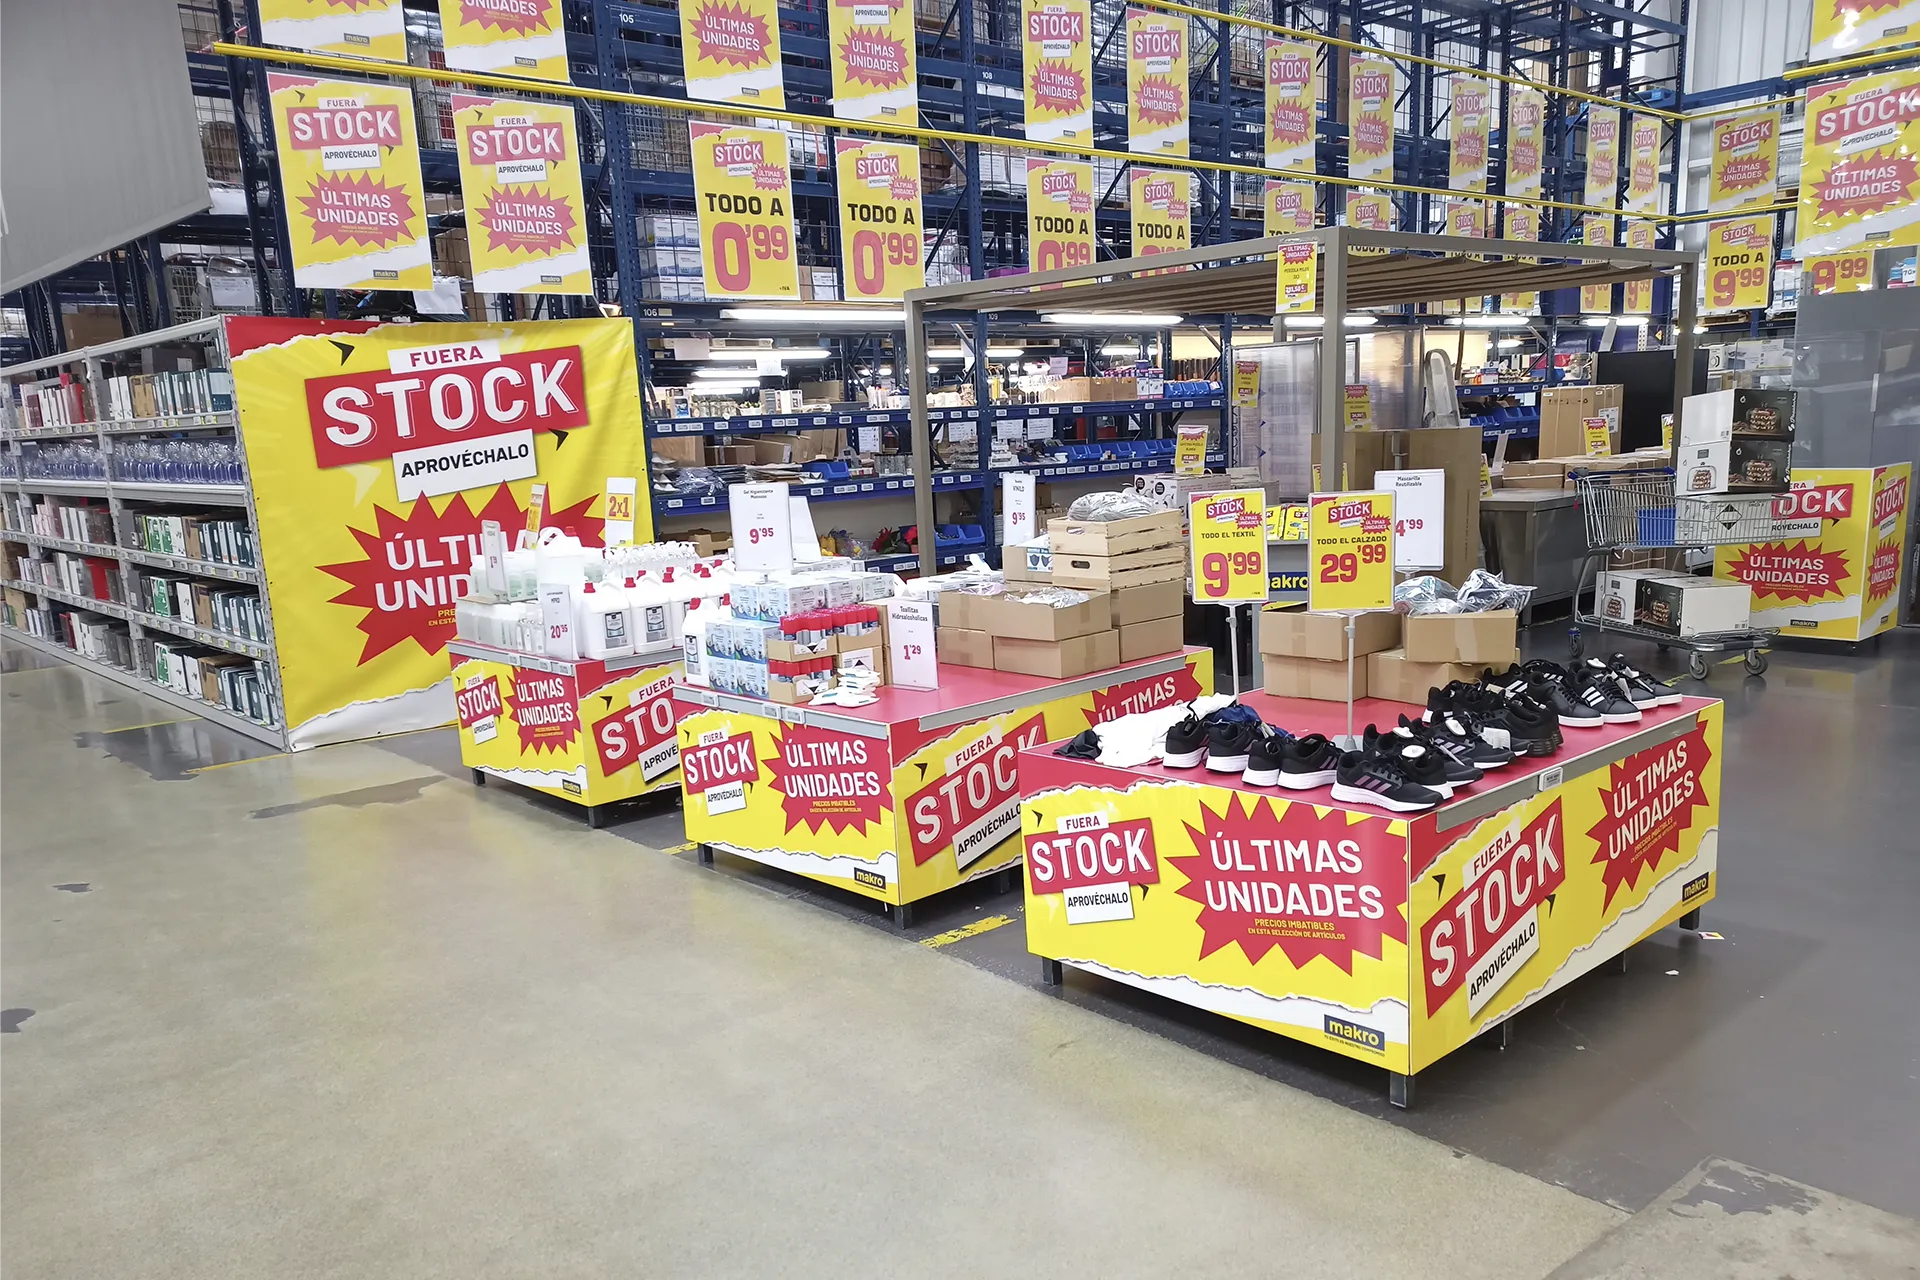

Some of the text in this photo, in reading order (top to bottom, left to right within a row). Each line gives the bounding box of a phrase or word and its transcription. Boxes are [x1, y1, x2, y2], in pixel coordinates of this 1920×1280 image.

[619, 13, 634, 24] 105
[705, 12, 755, 34] ÚLTIMAS
[1030, 15, 1080, 36] STOCK
[346, 34, 368, 44] makro
[702, 30, 760, 51] UNIDADES
[852, 37, 895, 58] ÚLTIMAS
[1135, 34, 1179, 54] STOCK
[849, 54, 899, 73] UNIDADES
[1271, 61, 1309, 79] STOCK
[982, 71, 993, 80] 108
[1040, 69, 1075, 87] ÚLTIMAS
[1038, 84, 1078, 100] UNIDADES
[1143, 84, 1174, 101] ÚLTIMAS
[1354, 77, 1388, 95] STOCK
[1854, 88, 1884, 102] FUERA
[1141, 98, 1177, 113] UNIDADES
[1513, 106, 1539, 122] STOCK
[1819, 87, 1919, 137] STOCK
[1277, 108, 1303, 122] ÚLTIMAS
[293, 110, 397, 142] STOCK
[1275, 119, 1305, 133] UNIDADES
[1591, 123, 1615, 138] STOCK
[1721, 122, 1771, 148] STOCK
[472, 128, 561, 157] STOCK
[1634, 130, 1657, 145] STOCK
[324, 150, 378, 160] APROVÉCHALO
[715, 144, 762, 163] STOCK
[498, 165, 544, 174] APROVÉCHALO
[857, 157, 898, 175] STOCK
[1727, 162, 1760, 175] ÚLTIMAS
[1043, 174, 1076, 191] STOCK
[1723, 170, 1763, 183] UNIDADES
[1831, 165, 1897, 186] ÚLTIMAS
[320, 187, 391, 209] ÚLTIMAS
[1145, 185, 1174, 200] STOCK
[1825, 180, 1901, 201] UNIDADES
[495, 199, 555, 219] ÚLTIMAS
[705, 193, 784, 216] TODO A
[1276, 194, 1301, 209] STOCK
[317, 208, 399, 226] UNIDADES
[847, 203, 915, 225] TODO A
[1356, 205, 1379, 219] STOCK
[492, 219, 562, 235] UNIDADES
[1035, 216, 1089, 235] TODO A
[1456, 214, 1475, 229] STOCK
[1512, 217, 1529, 231] STOCK
[1137, 223, 1185, 240] TODO A
[1590, 228, 1606, 240] STOCK
[1633, 230, 1647, 243] STOCK
[1722, 224, 1755, 240] STOCK
[1713, 252, 1764, 267] TODO A
[643, 309, 657, 317] 106
[409, 345, 484, 368] FUERA
[322, 358, 580, 448] STOCK
[401, 443, 530, 479] APROVÉCHALO
[608, 496, 630, 518] 2x1
[1207, 499, 1244, 516] STOCK
[1874, 481, 1905, 520] STOCK
[1330, 502, 1371, 520] STOCK
[1750, 553, 1824, 570] ÚLTIMAS
[1874, 553, 1895, 569] ÚLTIMAS
[1271, 574, 1309, 589] akro
[1743, 569, 1829, 585] UNIDADES
[1872, 567, 1895, 584] UNIDADES
[375, 573, 472, 612] UNID
[1792, 620, 1817, 628] makro
[516, 678, 565, 703] ÚLTIMAS
[639, 676, 675, 700] FUERA
[458, 681, 501, 720] STOCK
[517, 702, 574, 727] UNIDADES
[601, 697, 675, 760] STO
[703, 731, 724, 744] FUERA
[785, 738, 868, 768] ÚLTIMAS
[955, 734, 994, 766] FUERA
[684, 738, 756, 785] STOCK
[783, 772, 881, 798] UNIDADES
[1613, 740, 1687, 819] ÚLTIMAS
[1066, 815, 1101, 830] FUERA
[1608, 769, 1695, 860] UNIDADES
[1031, 828, 1153, 883] STOCK
[1209, 831, 1364, 874] ÚLTIMAS
[1472, 829, 1513, 877] FUERA
[857, 870, 883, 887] makro
[1684, 876, 1707, 898] makro
[1067, 892, 1129, 908] APROVÉCHALO
[1204, 880, 1385, 920] UNIDADES
[1429, 812, 1562, 988] STOCK
[1254, 918, 1335, 931] PRECIOS IMBATIBLES
[1257, 928, 1271, 936] ESTA
[1271, 928, 1302, 937] SELECCIÓN
[1312, 931, 1346, 940] ARTÍCULOS
[1469, 921, 1536, 1001] APROVÉCHALO
[1329, 1020, 1379, 1046] makro
